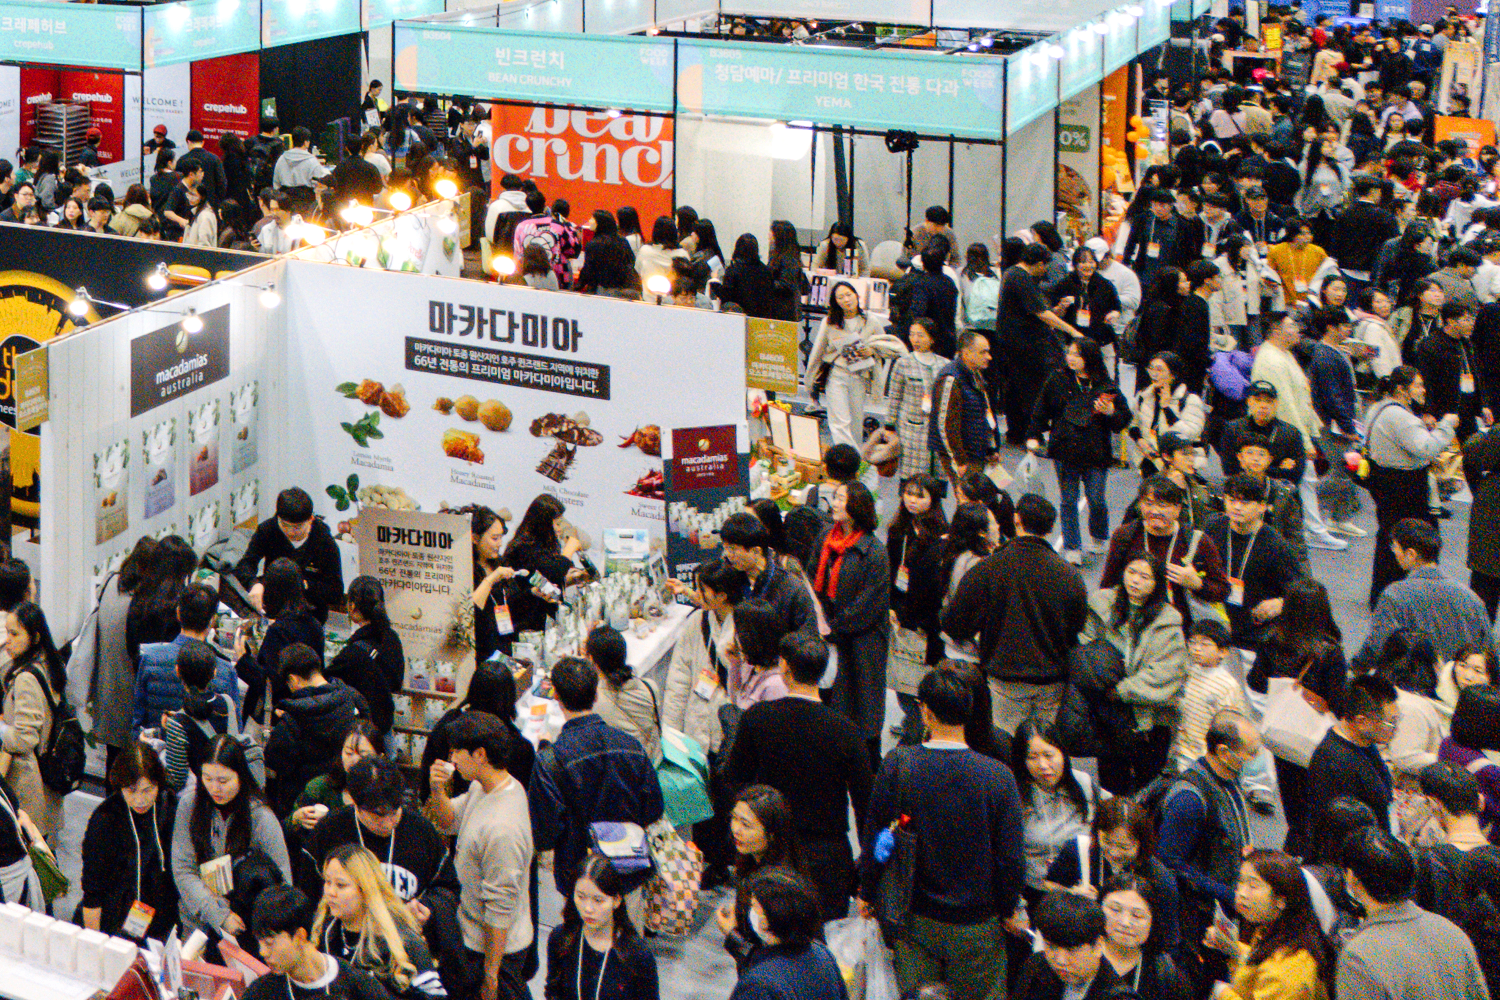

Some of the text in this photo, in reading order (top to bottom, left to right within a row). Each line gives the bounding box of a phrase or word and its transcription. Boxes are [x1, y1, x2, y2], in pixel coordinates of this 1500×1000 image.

[495, 46, 565, 70] 빈크런치
[488, 71, 573, 89] BEAN CRUNCHY
[786, 68, 849, 91] 프리미엄
[852, 72, 886, 93] 한국
[925, 77, 960, 99] 다과
[72, 91, 113, 104] crepehub
[131, 95, 178, 107] WLCOME
[815, 95, 852, 109] YEMA
[203, 102, 248, 114] crepehub
[428, 299, 583, 353] 마카다미아
[155, 352, 209, 385] macadamias
[414, 341, 452, 356] 마카다미아
[468, 349, 500, 365] 원산지인
[500, 354, 517, 366] 호주
[550, 361, 574, 375] 지역에
[574, 366, 600, 380] 위치한
[413, 354, 600, 394] 66년 전통의 프리미엄 마카다미아입니다.
[160, 371, 205, 398] australia
[350, 456, 394, 473] Macadamia
[680, 453, 729, 466] macadamias
[685, 462, 725, 473] australia
[450, 475, 496, 492] Macadamia
[631, 507, 666, 521] Macada
[376, 525, 454, 549] 마카다미아
[378, 548, 411, 560] 마카다미아
[426, 553, 453, 564] 원산지인
[378, 567, 454, 583] 66년 전통의 프리미엄
